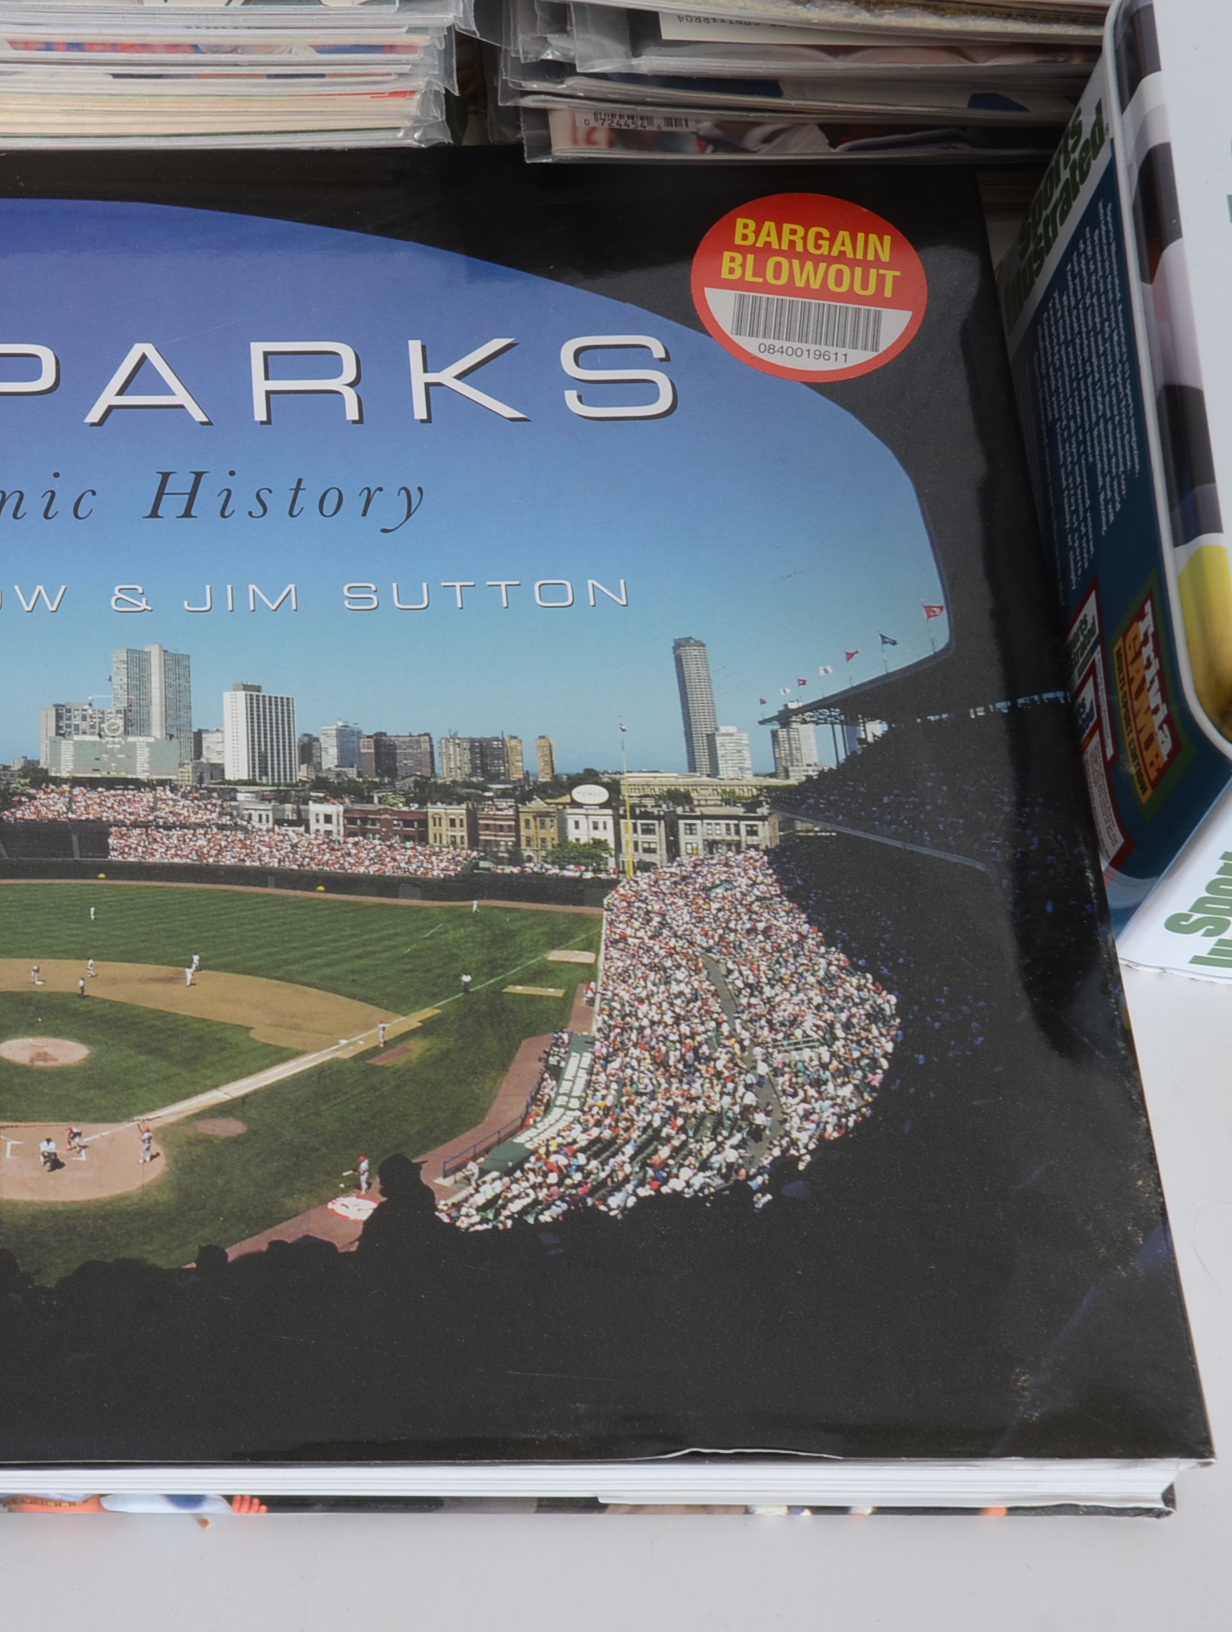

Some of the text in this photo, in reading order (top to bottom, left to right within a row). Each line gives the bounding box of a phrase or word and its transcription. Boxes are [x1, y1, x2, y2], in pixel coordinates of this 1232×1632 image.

[598, 118, 647, 130] 724454
[1018, 106, 1083, 263] Sports
[734, 217, 892, 263] BARGAIN
[720, 251, 901, 298] BLOWOUT
[757, 342, 849, 364] 0840019611
[142, 470, 426, 534] History
[110, 584, 153, 613] &
[183, 583, 299, 612] JIM
[343, 578, 629, 611] SUTTON
[1125, 621, 1166, 781] GAME
[1139, 599, 1174, 762] Trivia
